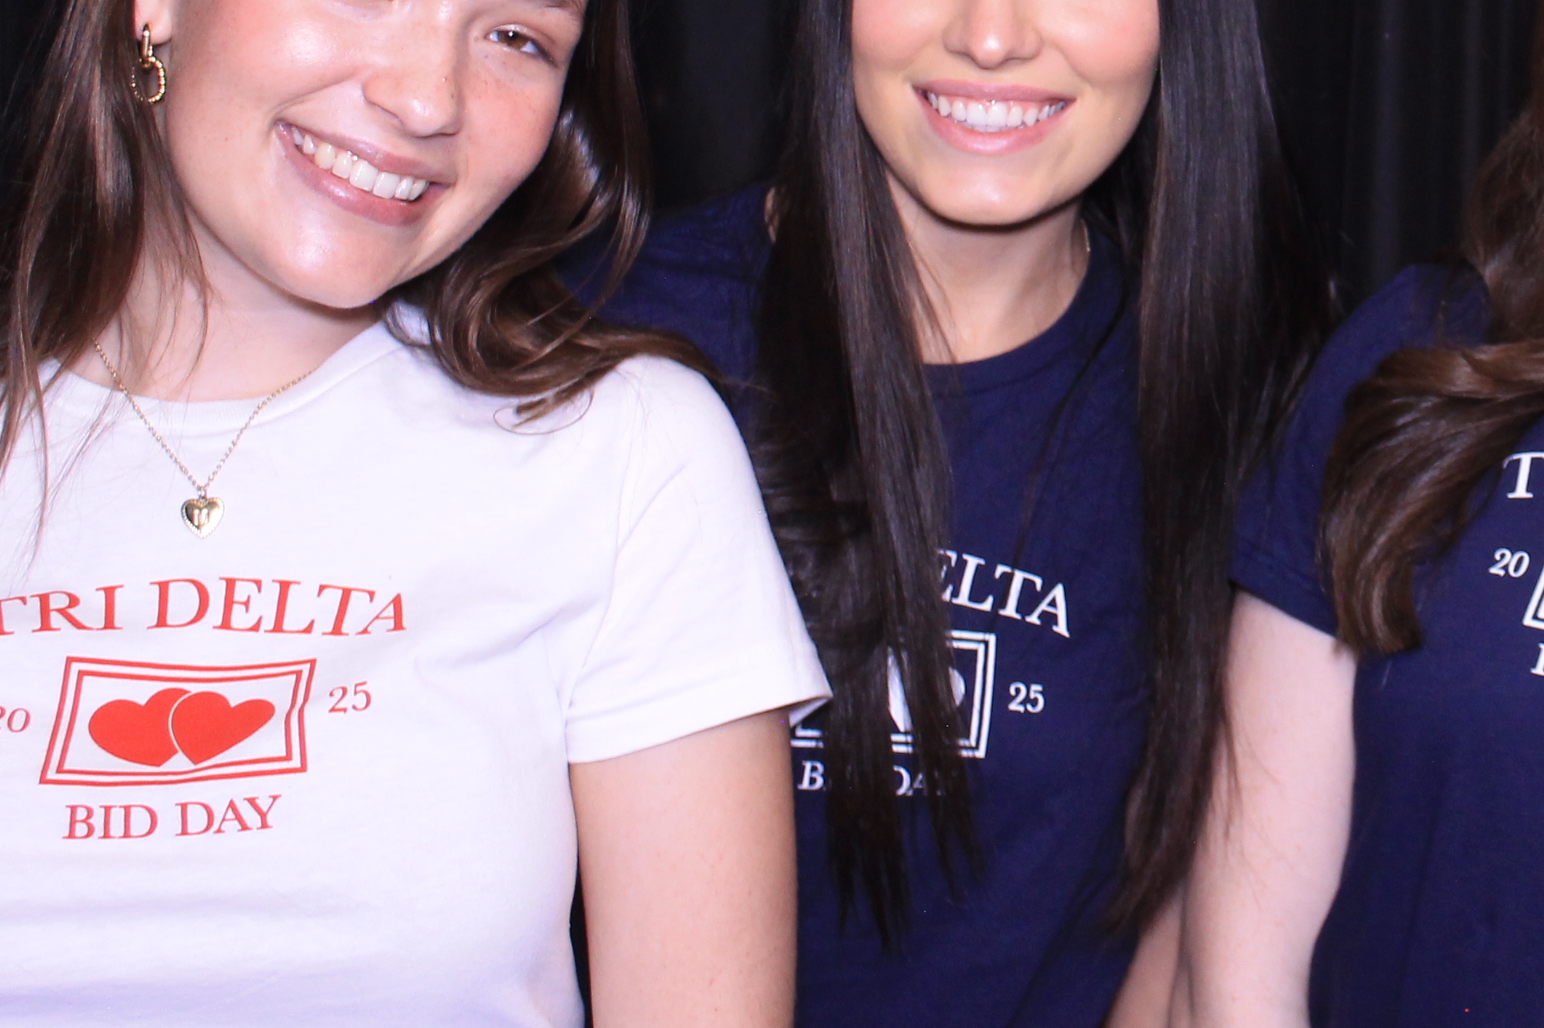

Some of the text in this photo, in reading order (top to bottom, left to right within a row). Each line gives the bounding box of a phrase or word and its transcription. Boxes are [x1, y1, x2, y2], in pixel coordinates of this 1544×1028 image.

[1488, 548, 1530, 578] 20
[147, 576, 407, 637] DELTA
[936, 548, 1071, 639] LTA
[0, 681, 372, 733] 0 25
[1007, 682, 1045, 714] 25
[62, 794, 282, 840] BID DAY
